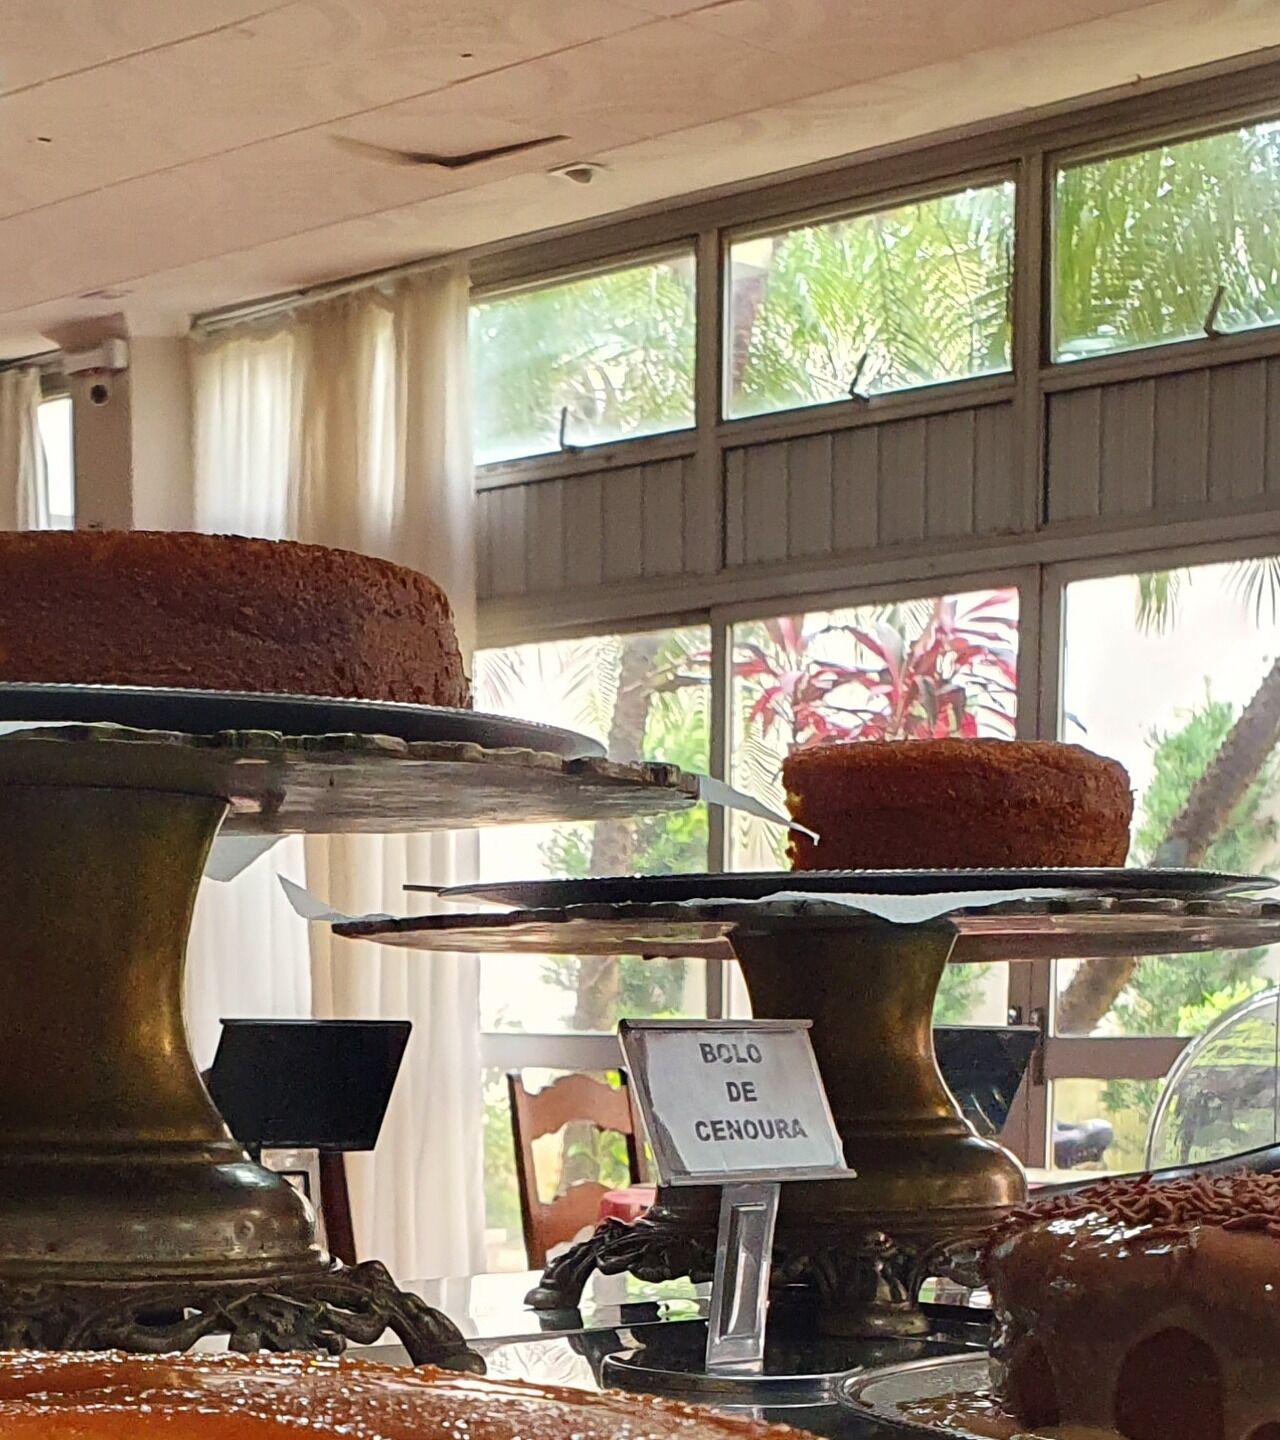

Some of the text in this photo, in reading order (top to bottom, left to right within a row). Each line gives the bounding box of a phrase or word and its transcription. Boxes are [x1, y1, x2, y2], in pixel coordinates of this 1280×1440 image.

[699, 1042, 763, 1064] BOLO
[725, 1081, 758, 1102] DE
[694, 1118, 808, 1142] CENOURA
